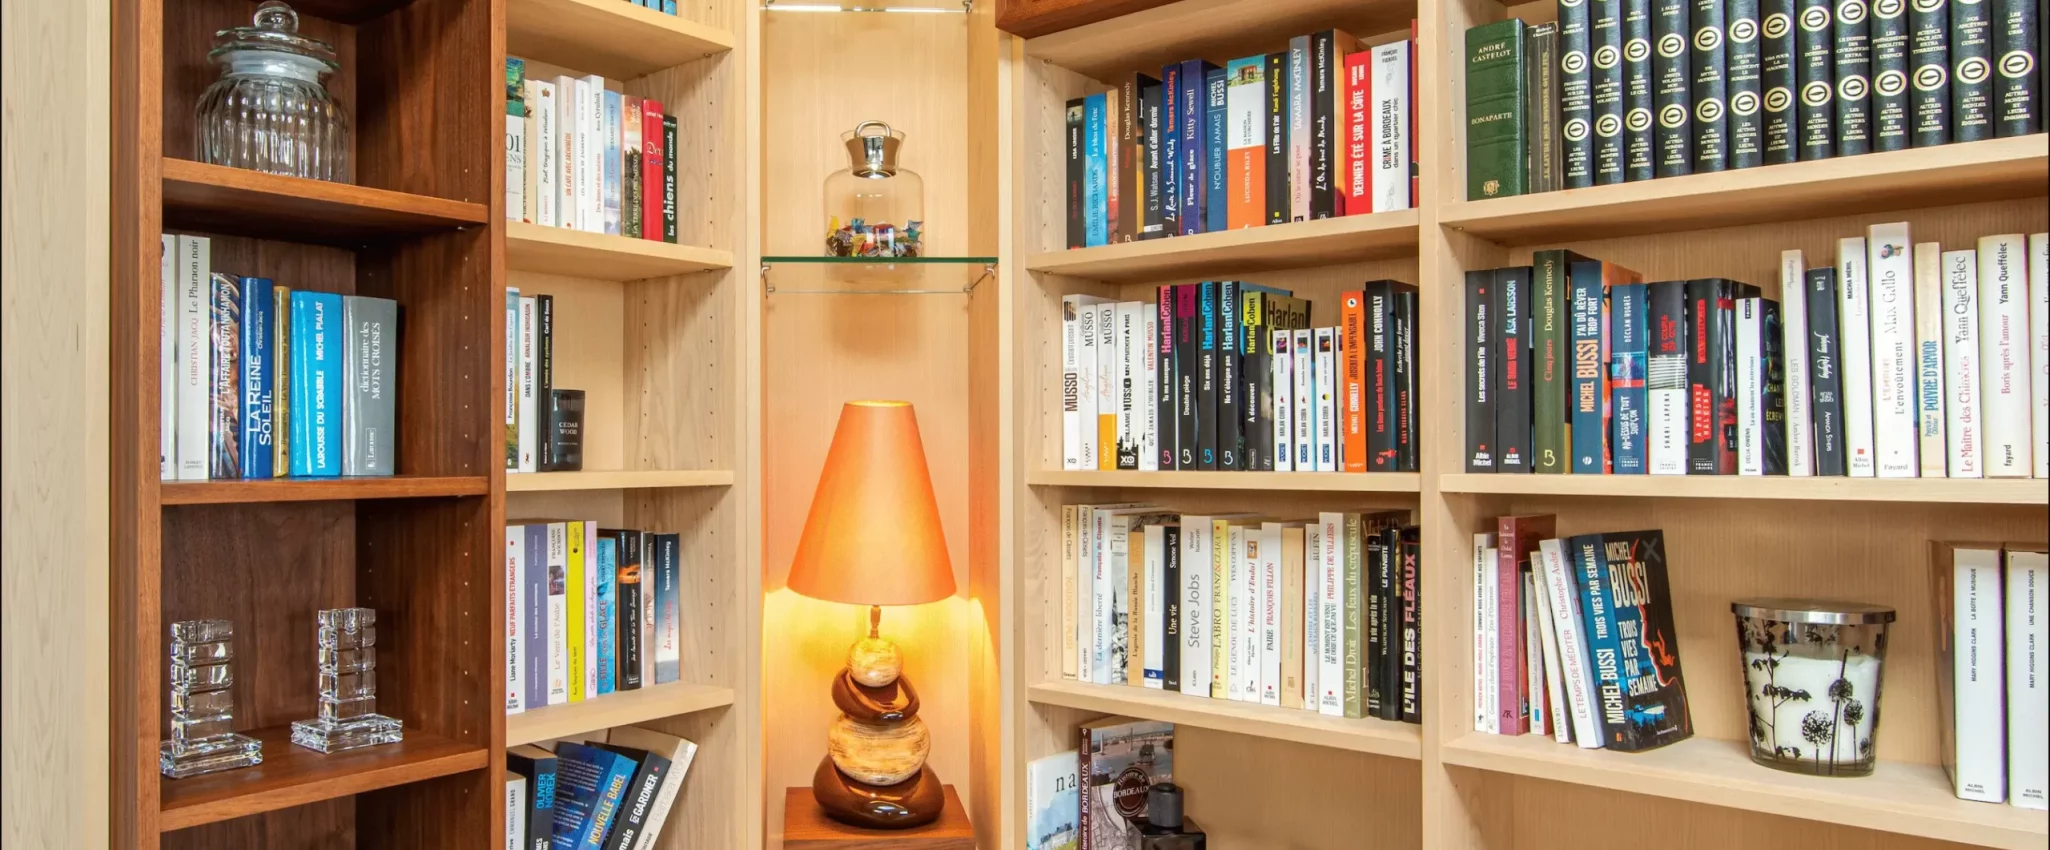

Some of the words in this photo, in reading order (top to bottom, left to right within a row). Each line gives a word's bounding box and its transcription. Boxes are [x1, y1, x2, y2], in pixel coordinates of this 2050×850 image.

[1318, 38, 1326, 68] McKinley
[1472, 49, 1512, 63] CASTELOT
[1293, 48, 1302, 91] McKINLEY
[1168, 71, 1176, 104] McKinley
[1216, 80, 1225, 105] BUSSI
[1351, 89, 1364, 110] CÔTE
[1150, 106, 1158, 128] dormir
[1293, 93, 1302, 130] TAMARA
[1352, 112, 1363, 122] LA
[1383, 99, 1391, 138] BORDEAUX
[1471, 112, 1512, 125] BONAPARTE
[1150, 129, 1158, 149] d'aller
[1213, 114, 1221, 144] JAMAIS
[1352, 124, 1364, 140] SUR
[1351, 144, 1364, 158] ÉTÉ
[1383, 147, 1392, 169] CRIME
[1393, 141, 1398, 150] un
[667, 161, 673, 171] du
[1150, 151, 1158, 169] Avant
[1213, 147, 1221, 189] N'OUBLIER
[1352, 160, 1364, 197] DERNIER
[663, 175, 674, 220] chiens
[189, 240, 198, 259] noir
[1998, 243, 2010, 282] Queffélec
[189, 261, 199, 299] Pharaon
[1544, 260, 1554, 296] Kennedy
[1882, 270, 1896, 303] Gallo
[1951, 256, 1971, 314] Queffélec
[189, 302, 198, 313] Le
[1202, 284, 1212, 313] Coben
[1574, 288, 1586, 310] RÊVER
[1588, 297, 1598, 315] FORT
[1999, 284, 2009, 304] Yann
[316, 301, 324, 330] PIALAT
[1267, 300, 1305, 326] Harlan
[1373, 296, 1383, 333] CONNOLLY
[1544, 297, 1554, 331] Douglas
[1574, 312, 1586, 322] DÛ
[1588, 317, 1598, 336] TROP
[1884, 307, 1897, 334] Max
[360, 322, 369, 337] des
[1085, 312, 1094, 347] MUSSO
[1104, 310, 1112, 344] MUSSO
[1202, 314, 1213, 349] Harlan
[1576, 324, 1587, 336] J'AI
[1954, 316, 1969, 344] Yann
[1999, 314, 2010, 346] l'amour
[316, 332, 324, 360] MICHEL
[369, 323, 380, 366] CROISÉS
[1374, 334, 1383, 352] JOHN
[1544, 340, 1554, 360] jours
[360, 339, 369, 392] dictionnaire
[1203, 355, 1211, 367] déjà
[1544, 361, 1554, 381] Cinq
[1576, 340, 1598, 378] BUSSI
[1922, 341, 1938, 377] D'ARVOR
[2001, 348, 2014, 370] après
[247, 355, 261, 404] REINE
[316, 371, 324, 409] SCRABBLE
[372, 369, 380, 399] MOTS
[1894, 342, 1905, 414] L'envoûtement
[2001, 372, 2011, 394] Boris
[1580, 382, 1595, 412] MICHEL
[1923, 378, 1939, 411] POIVRE
[248, 410, 261, 432] LA
[260, 390, 272, 445] SOLEIL
[316, 412, 324, 424] DU
[316, 426, 325, 468] LAROUSSE
[2003, 445, 2014, 466] fayard
[1346, 519, 1359, 569] crépuscule
[1604, 541, 1630, 561] MICHEL
[1327, 556, 1334, 565] DE
[1583, 544, 1599, 578] SEMAINE
[1266, 562, 1274, 589] FILLON
[1345, 571, 1356, 585] du
[1381, 578, 1388, 588] LE
[1402, 554, 1415, 622] FLÉAUX
[1588, 580, 1601, 595] PAR
[1609, 561, 1651, 608] BUSSI
[1187, 574, 1200, 606] Jobs
[1345, 588, 1357, 608] feux
[1169, 605, 1177, 616] vie
[1266, 590, 1275, 625] FRANÇOIS
[1591, 597, 1605, 615] VIES
[1169, 618, 1177, 634] Une
[1188, 610, 1200, 648] Steve
[1345, 611, 1356, 630] Les
[1594, 616, 1609, 639] TROIS
[1617, 620, 1638, 639] TROIS
[1266, 629, 1274, 651] FAIRE
[1345, 639, 1356, 665] Droit
[1404, 628, 1415, 666] DES
[1564, 629, 1579, 666] MÉDITER
[1620, 639, 1638, 658] VIES
[1571, 667, 1580, 679] DE
[1596, 648, 1618, 680] BUSSI
[1624, 657, 1640, 677] PAR
[1345, 668, 1356, 702] Michel
[1404, 671, 1415, 713] L'ILE
[1574, 680, 1585, 706] TEMPS
[1628, 673, 1658, 696] SEMAINE
[1579, 707, 1587, 718] LE
[1603, 682, 1626, 724] MICHEL
[633, 774, 659, 816] GARDNER
[588, 800, 614, 844] NOUVELLE
[605, 774, 626, 799] BABEL
